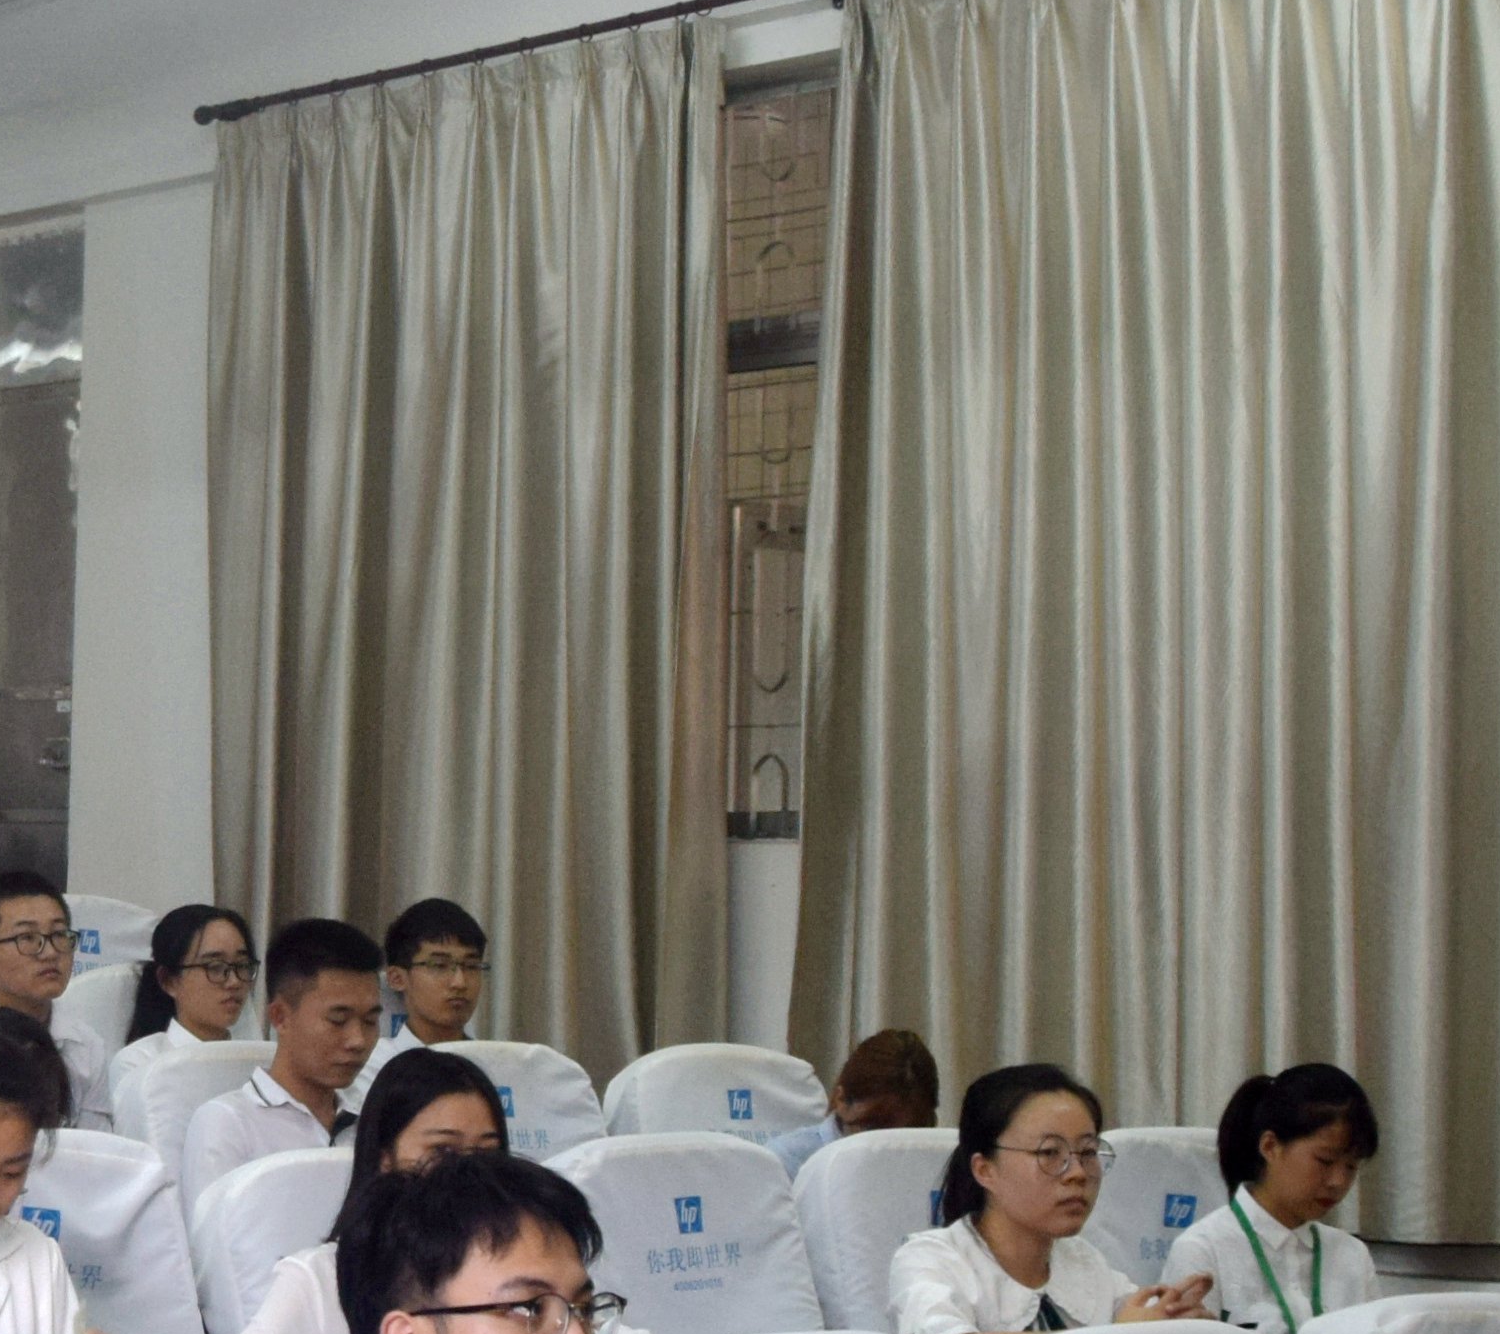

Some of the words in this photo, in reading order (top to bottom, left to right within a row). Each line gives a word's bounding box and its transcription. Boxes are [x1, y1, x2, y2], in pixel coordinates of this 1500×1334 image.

[80, 930, 99, 953] hp
[731, 1091, 751, 1118] hp
[679, 1198, 700, 1233] hp
[1168, 1196, 1192, 1227] hp
